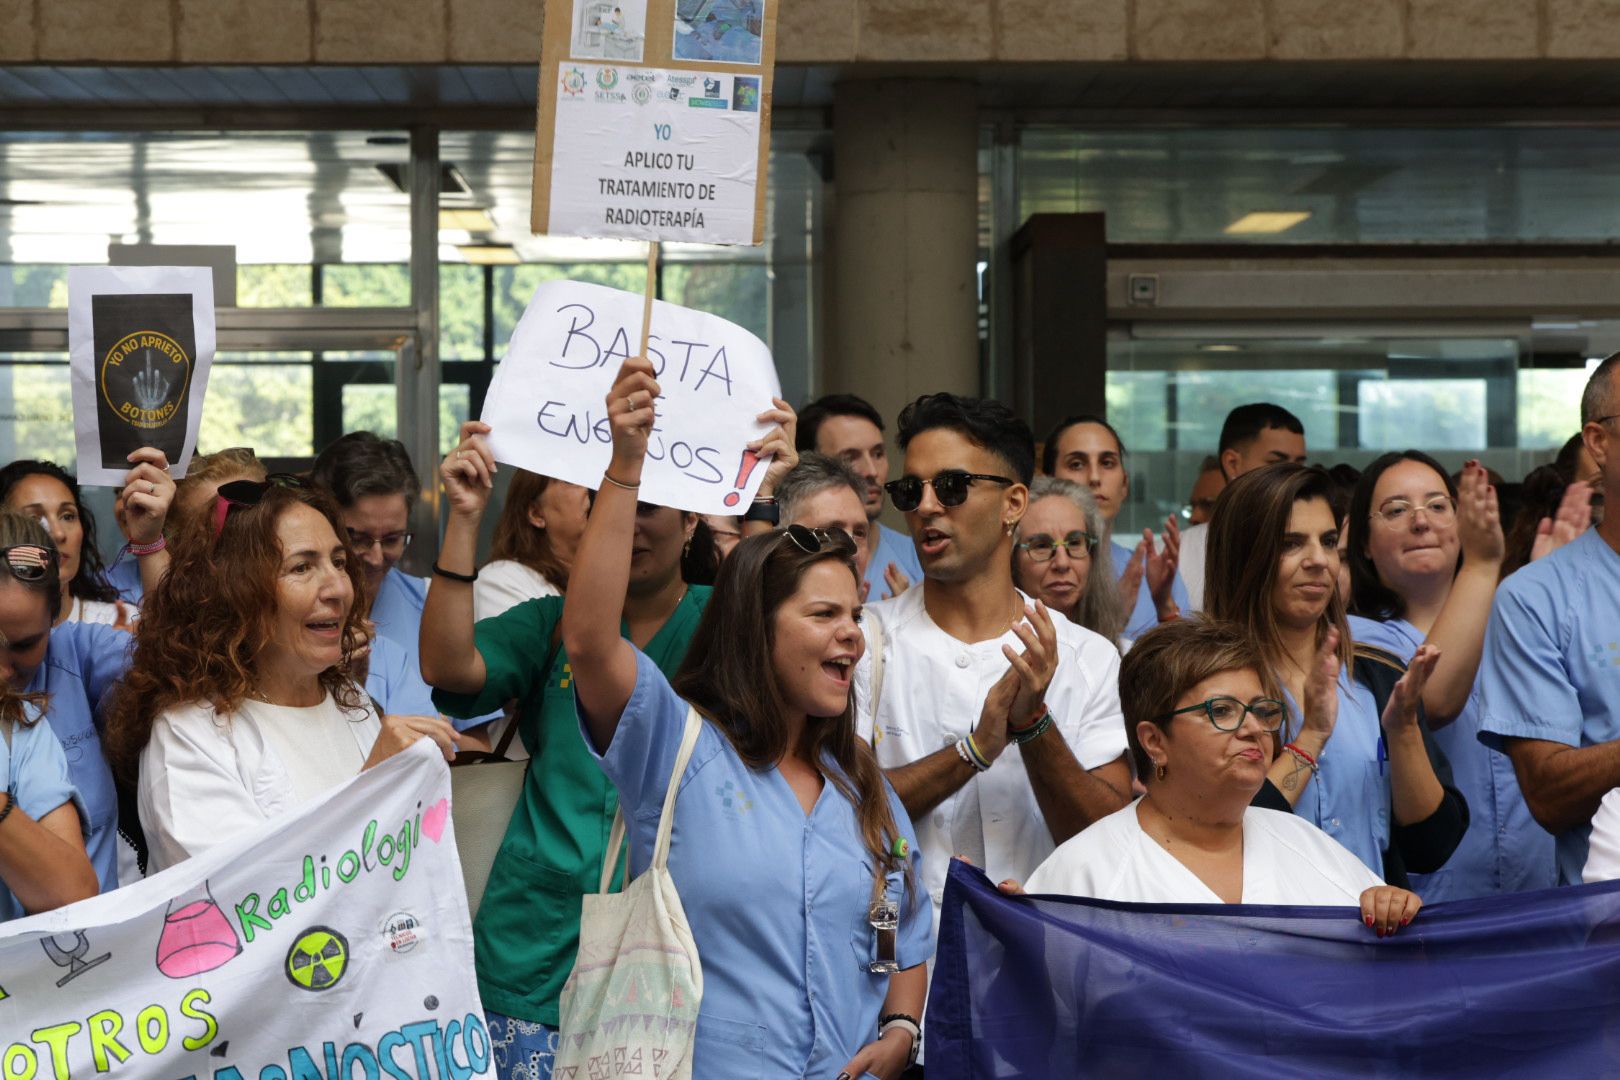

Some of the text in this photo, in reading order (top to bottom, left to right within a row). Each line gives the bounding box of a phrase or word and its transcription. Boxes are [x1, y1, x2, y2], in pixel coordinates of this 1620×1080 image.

[654, 123, 672, 141] YO
[624, 151, 694, 170] APLICO TU
[598, 178, 716, 201] TRATAMIENTO DE
[605, 207, 705, 229] RADIOTERAPÍA
[109, 335, 183, 368] YO NO APRIETO
[549, 303, 733, 397] BASTA
[120, 400, 175, 421] BOTONES
